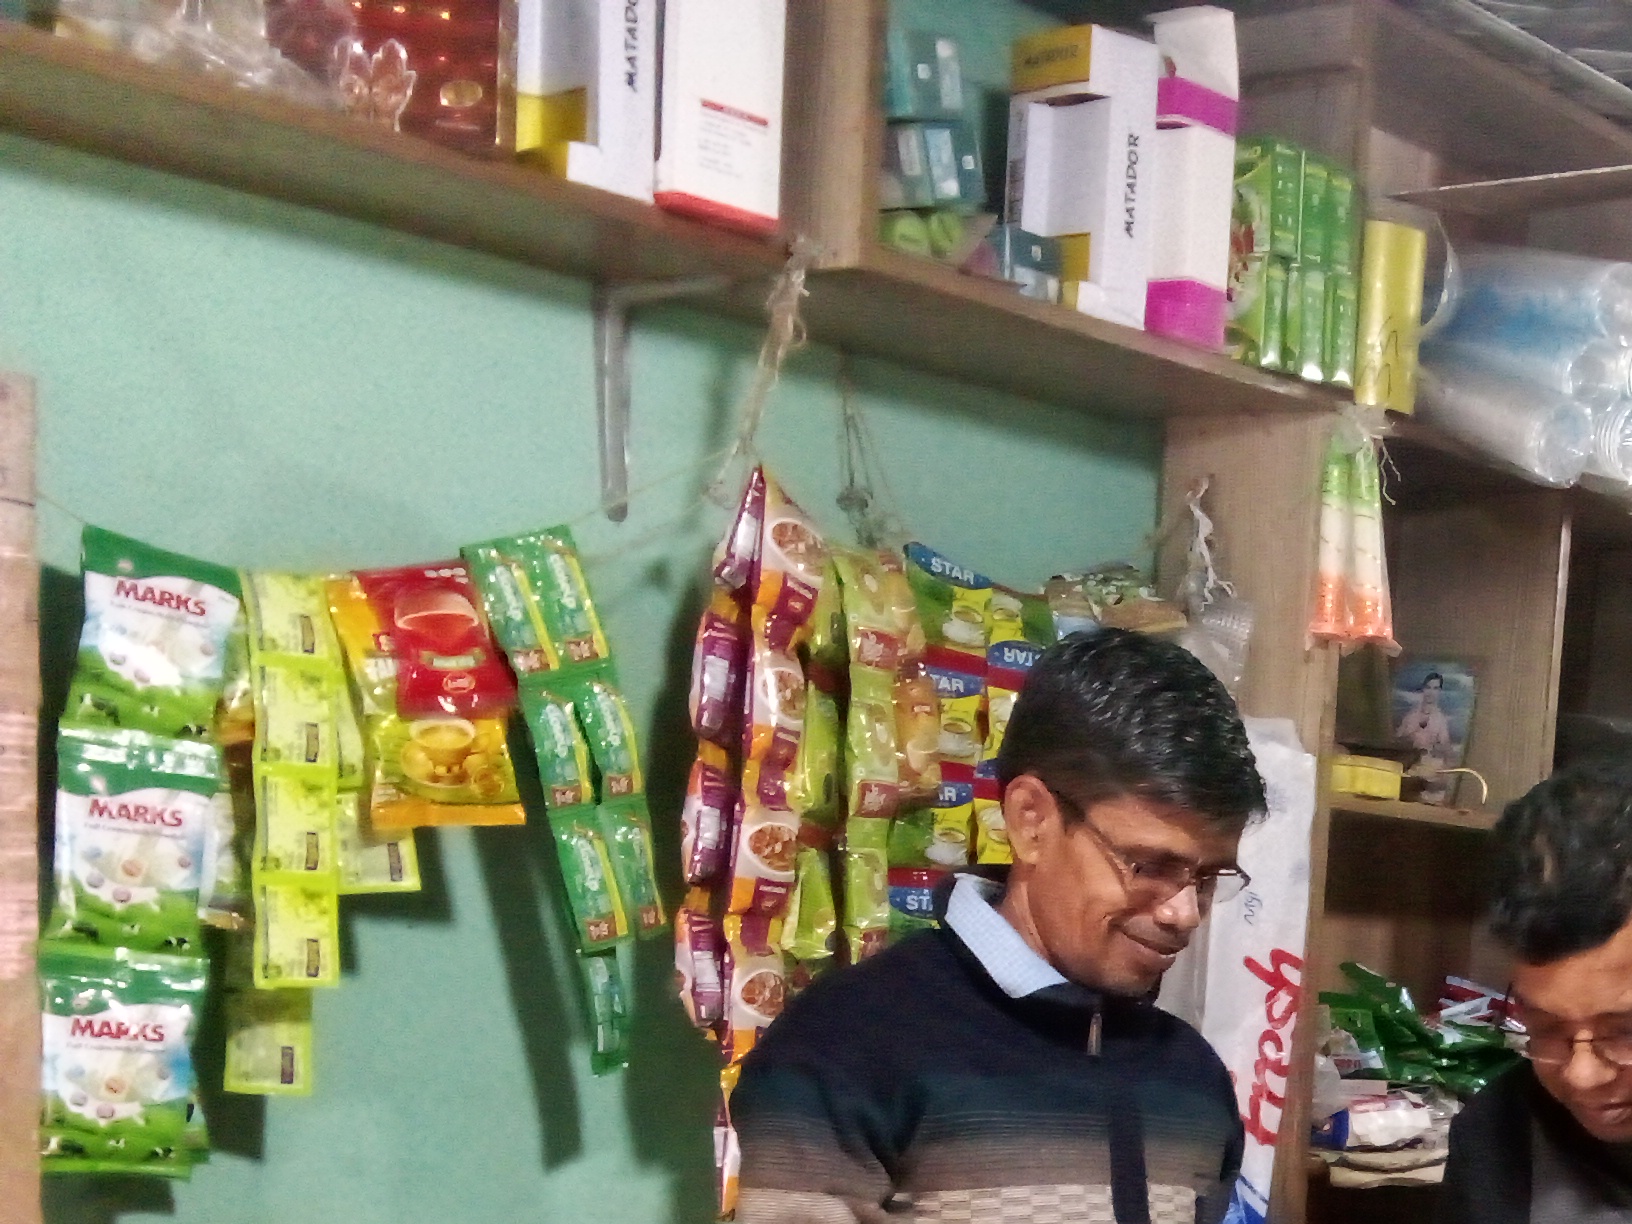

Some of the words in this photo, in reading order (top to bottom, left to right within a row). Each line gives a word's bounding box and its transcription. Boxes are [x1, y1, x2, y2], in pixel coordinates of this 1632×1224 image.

[1124, 134, 1140, 238] MATADOR
[931, 556, 974, 585] STAR
[116, 579, 206, 616] MARKS
[1003, 647, 1042, 667] TAR
[930, 674, 965, 693] TAR
[89, 799, 183, 827] MARKS
[905, 895, 934, 911] ST
[71, 1018, 165, 1042] MARKS
